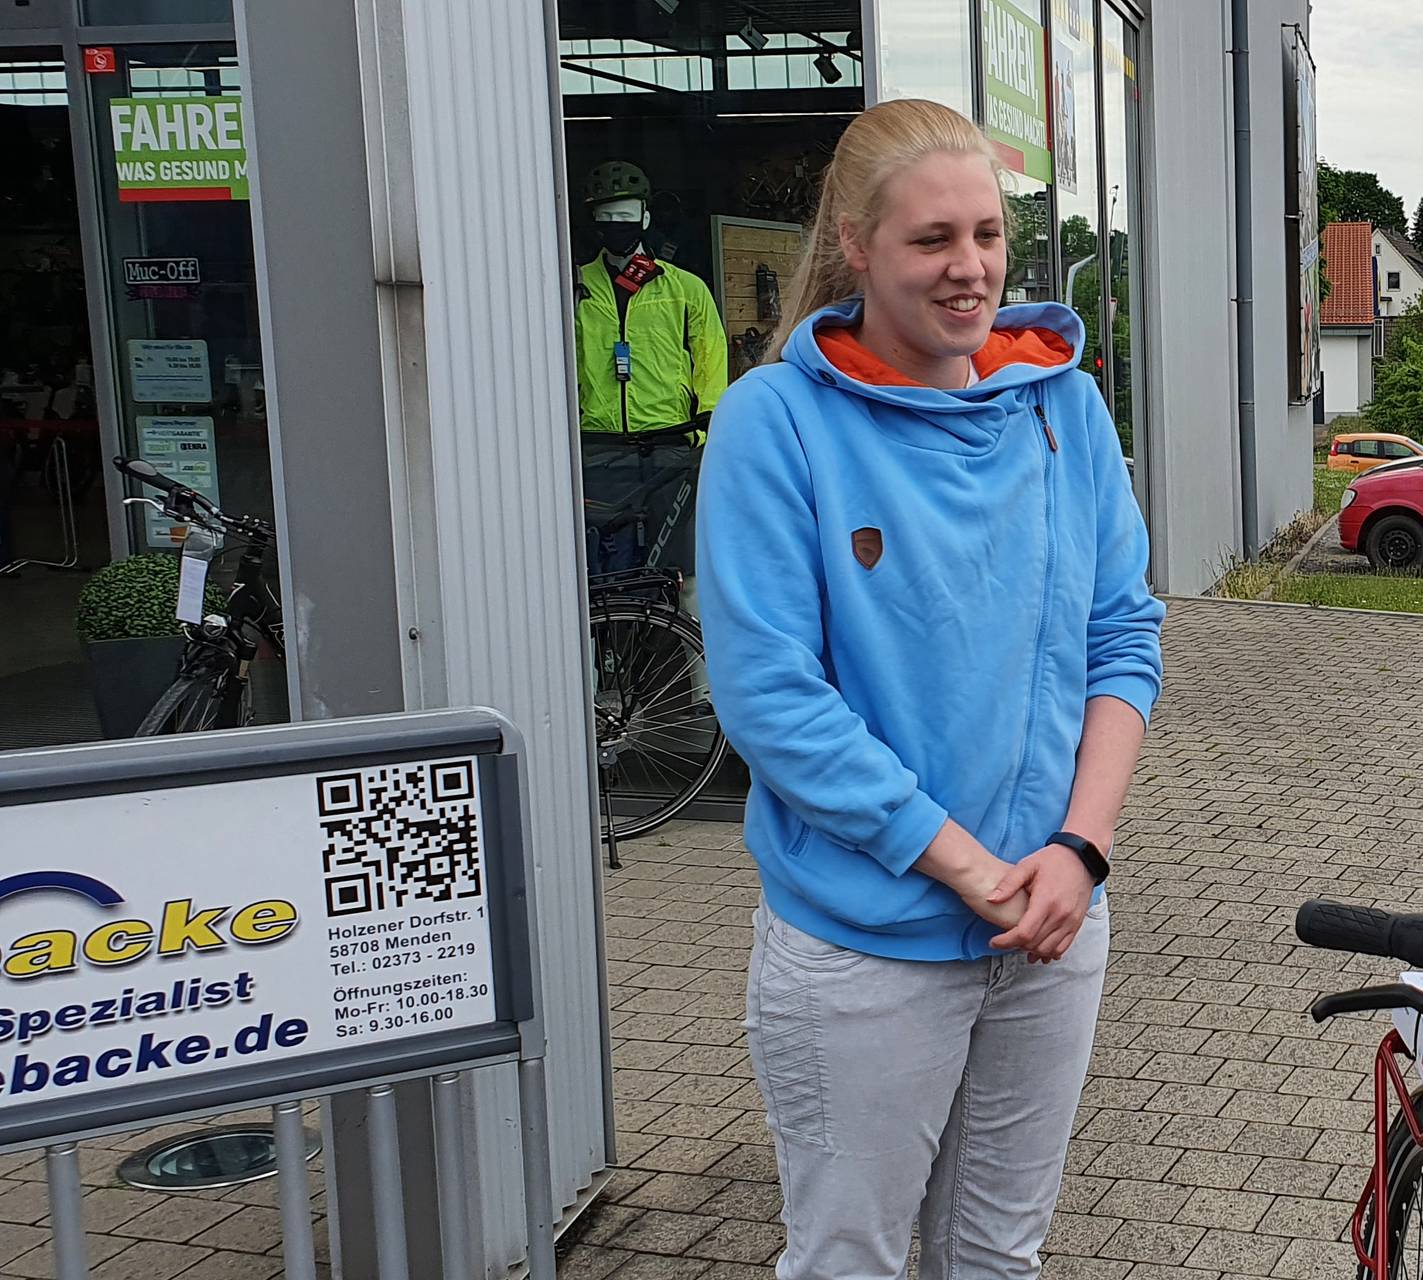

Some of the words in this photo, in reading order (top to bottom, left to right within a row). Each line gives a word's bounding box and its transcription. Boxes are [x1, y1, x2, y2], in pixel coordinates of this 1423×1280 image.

[110, 103, 247, 151] FAHRE
[116, 161, 156, 181] WAS
[159, 160, 230, 181] GESUND
[128, 261, 196, 281] Muc-Off
[646, 480, 692, 568] OCUS
[0, 898, 298, 978] acke
[328, 920, 405, 941] Holzener
[409, 910, 472, 929] Dorfstr.
[476, 906, 485, 919] 1
[329, 939, 380, 959] 58708
[385, 931, 452, 950] Menden
[331, 961, 367, 976] Tel.:
[372, 951, 422, 970] 02373
[437, 942, 476, 960] 2219
[333, 972, 468, 1003] Öffnungszeiten:
[335, 1001, 390, 1021] Mo-Fr:
[397, 984, 488, 1010] 10.00-18.30
[336, 1024, 364, 1038] Sa:
[369, 1007, 454, 1032] 9.30-16.00
